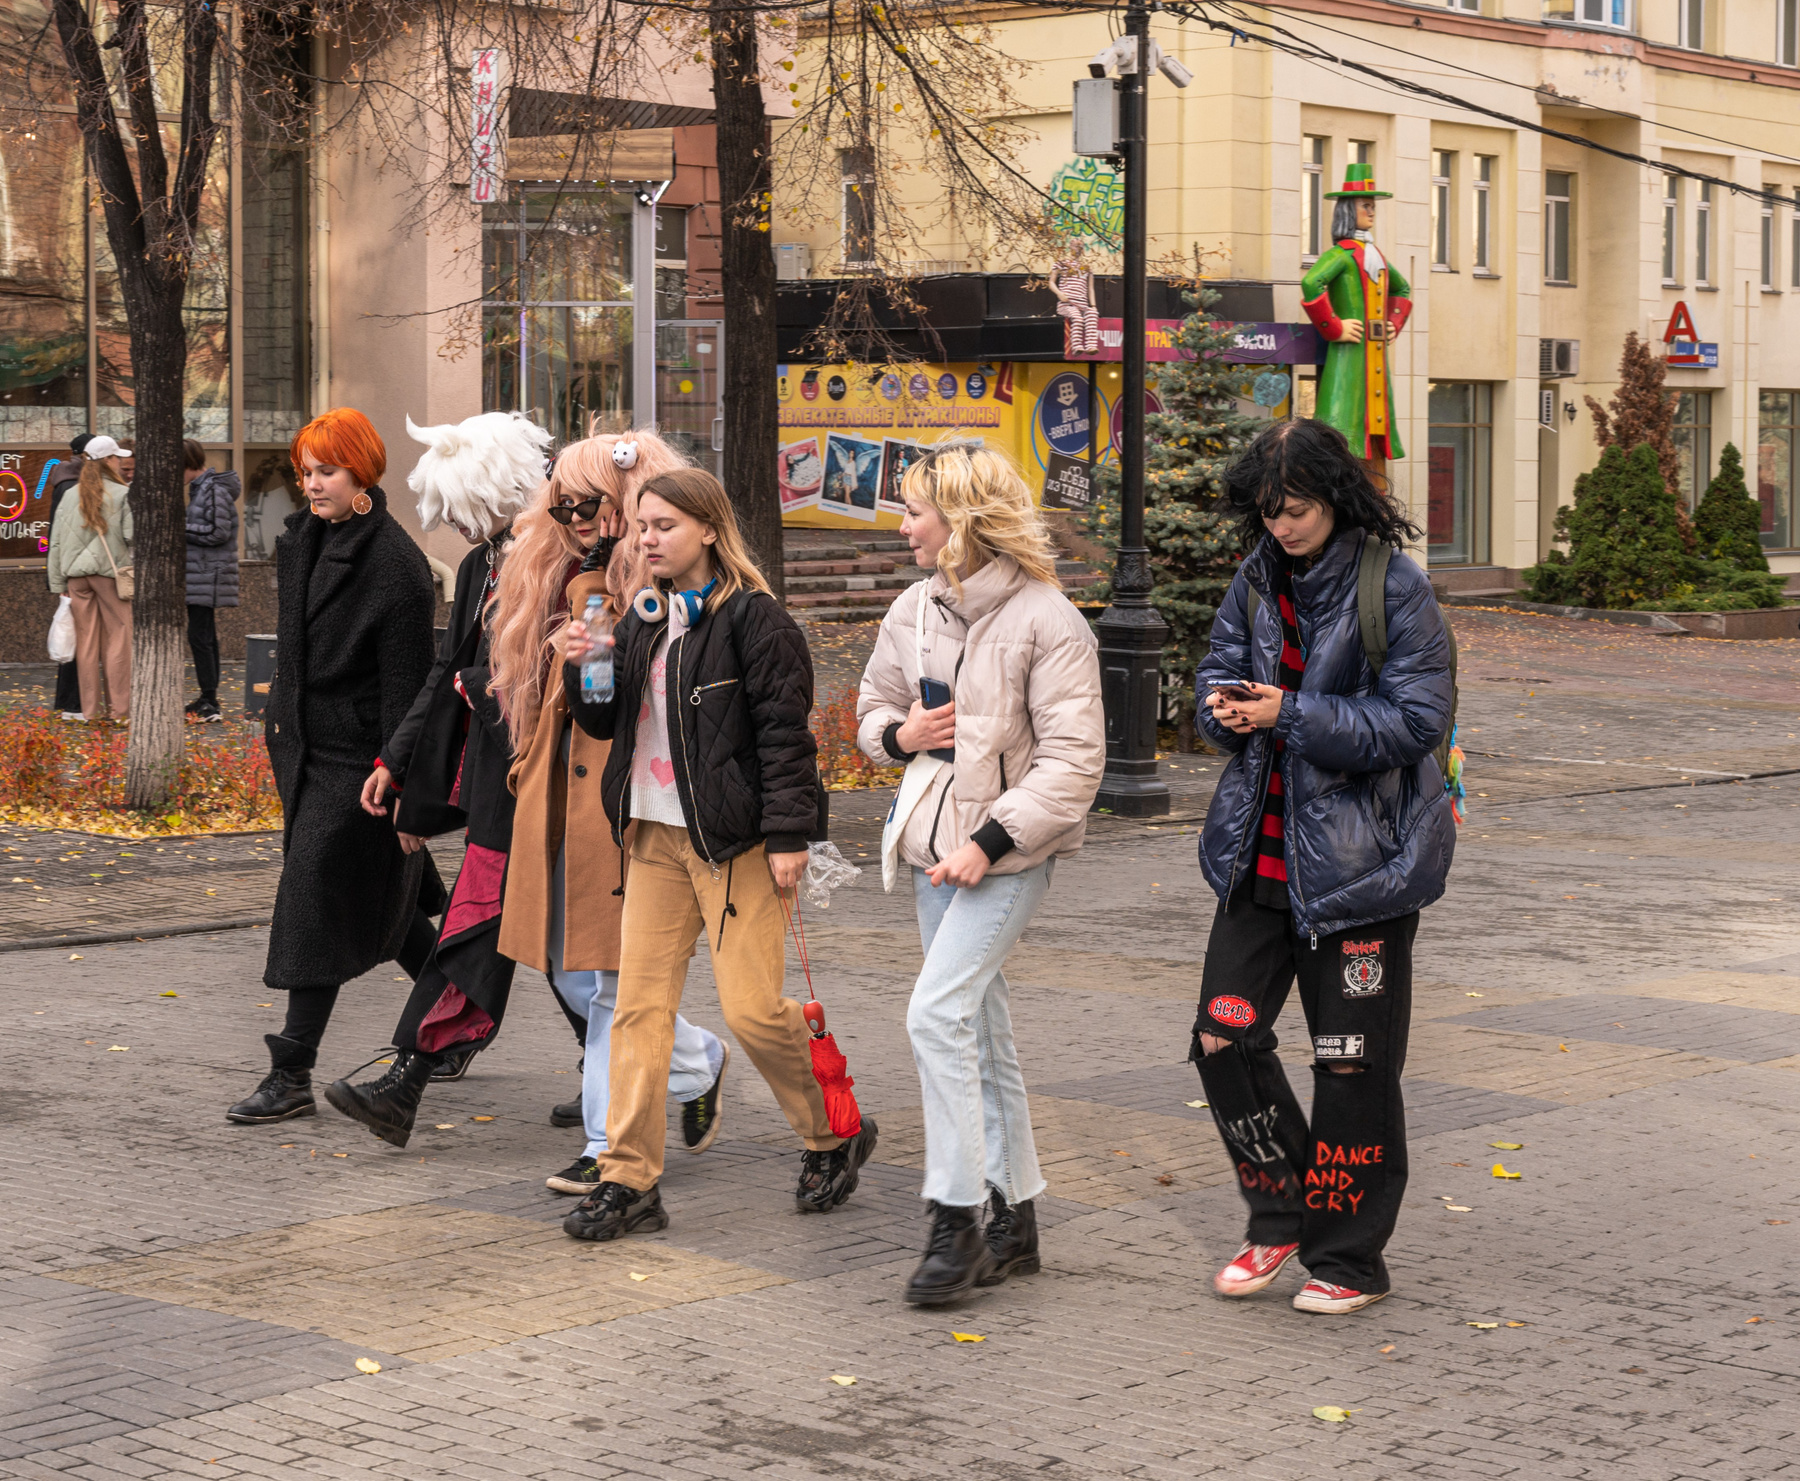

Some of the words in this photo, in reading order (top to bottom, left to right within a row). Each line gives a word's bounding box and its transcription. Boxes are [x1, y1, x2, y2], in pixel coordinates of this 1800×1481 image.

[778, 406, 894, 428] ЗВЛЕКАТЕЛЬНЫЕ
[1316, 1140, 1384, 1167] DANCE
[1304, 1168, 1354, 1191] AND
[1305, 1189, 1365, 1216] CRY
